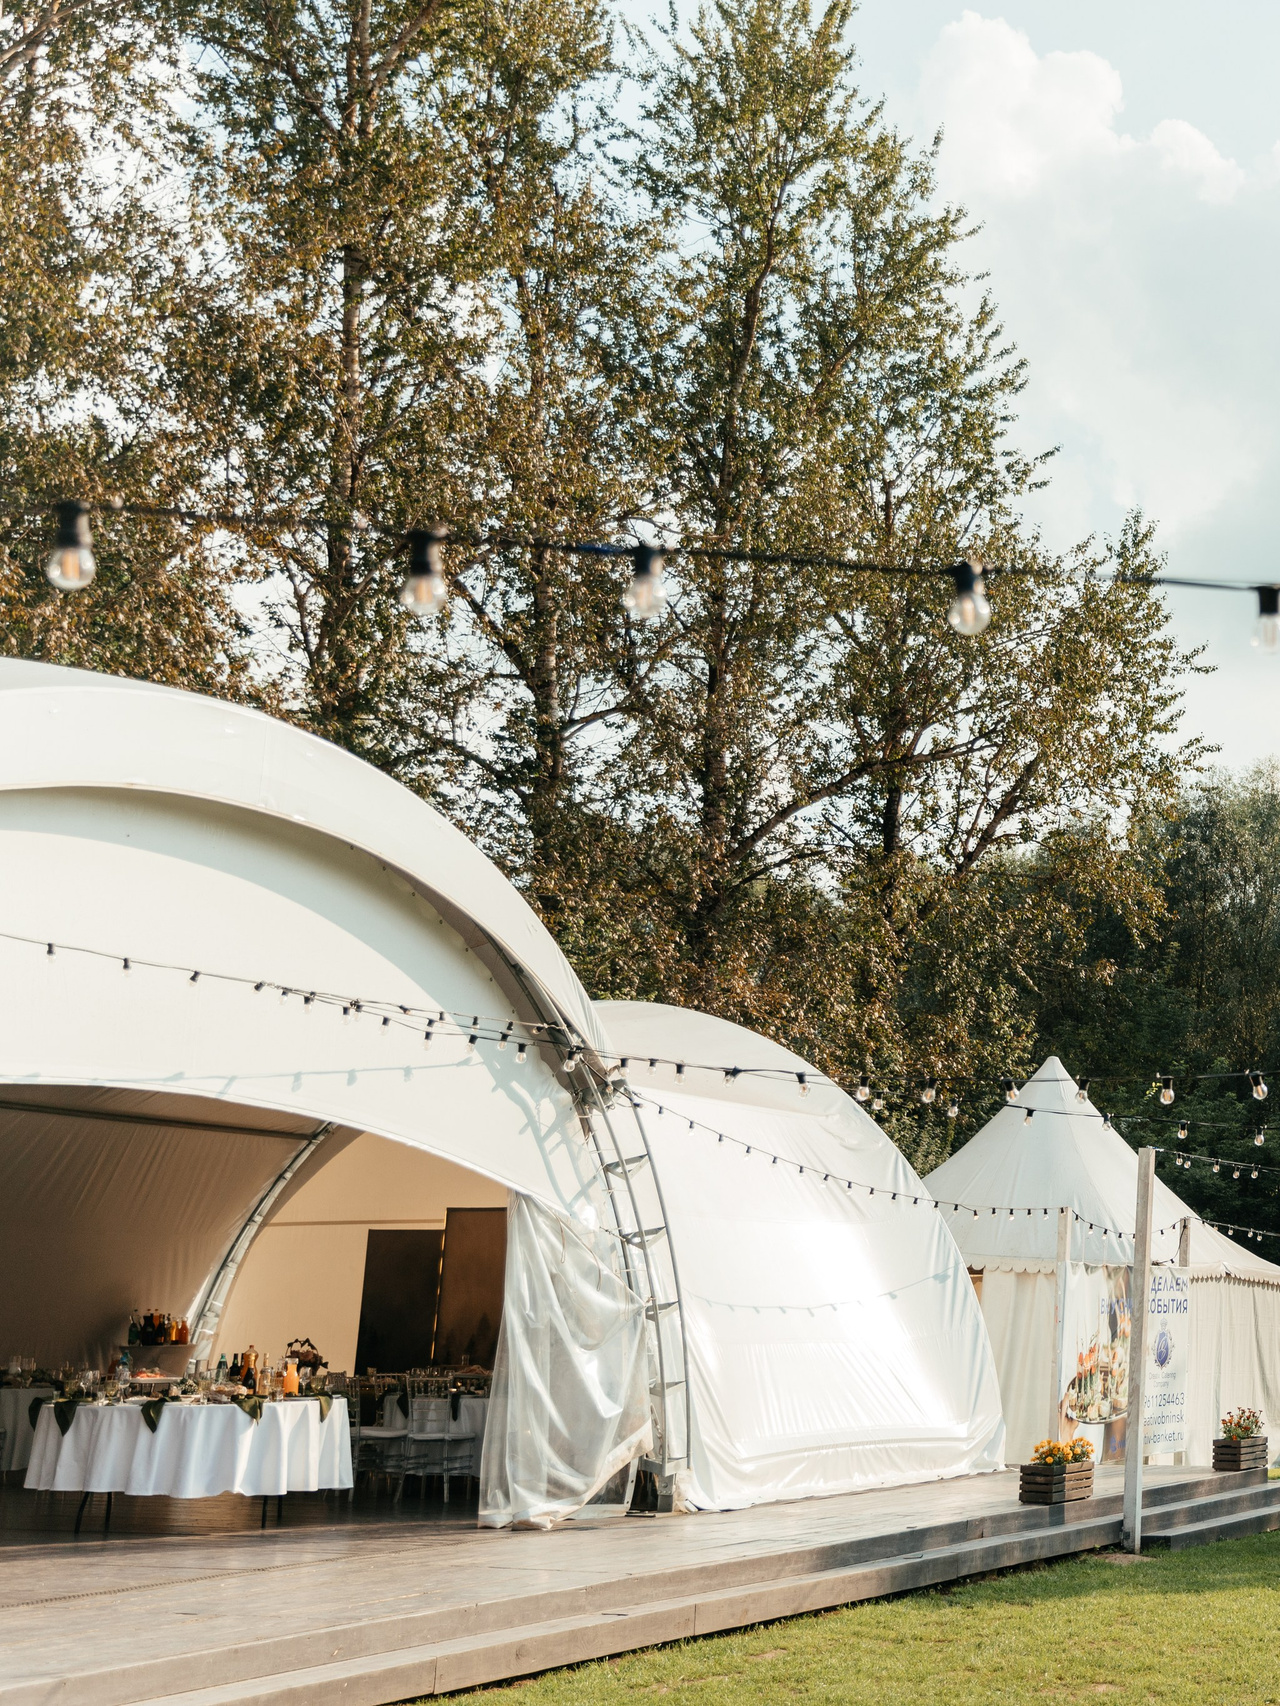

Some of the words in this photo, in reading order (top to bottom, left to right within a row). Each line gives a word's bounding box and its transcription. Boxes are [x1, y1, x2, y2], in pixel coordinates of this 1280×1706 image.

[1151, 1276, 1188, 1294] ДЕЛАЕМ
[1148, 1299, 1188, 1314] ОБЫТИЯ
[1144, 1392, 1185, 1408] 9611254463
[1144, 1409, 1184, 1426] eativobninsk
[1144, 1428, 1184, 1444] tiv-banket.ru
